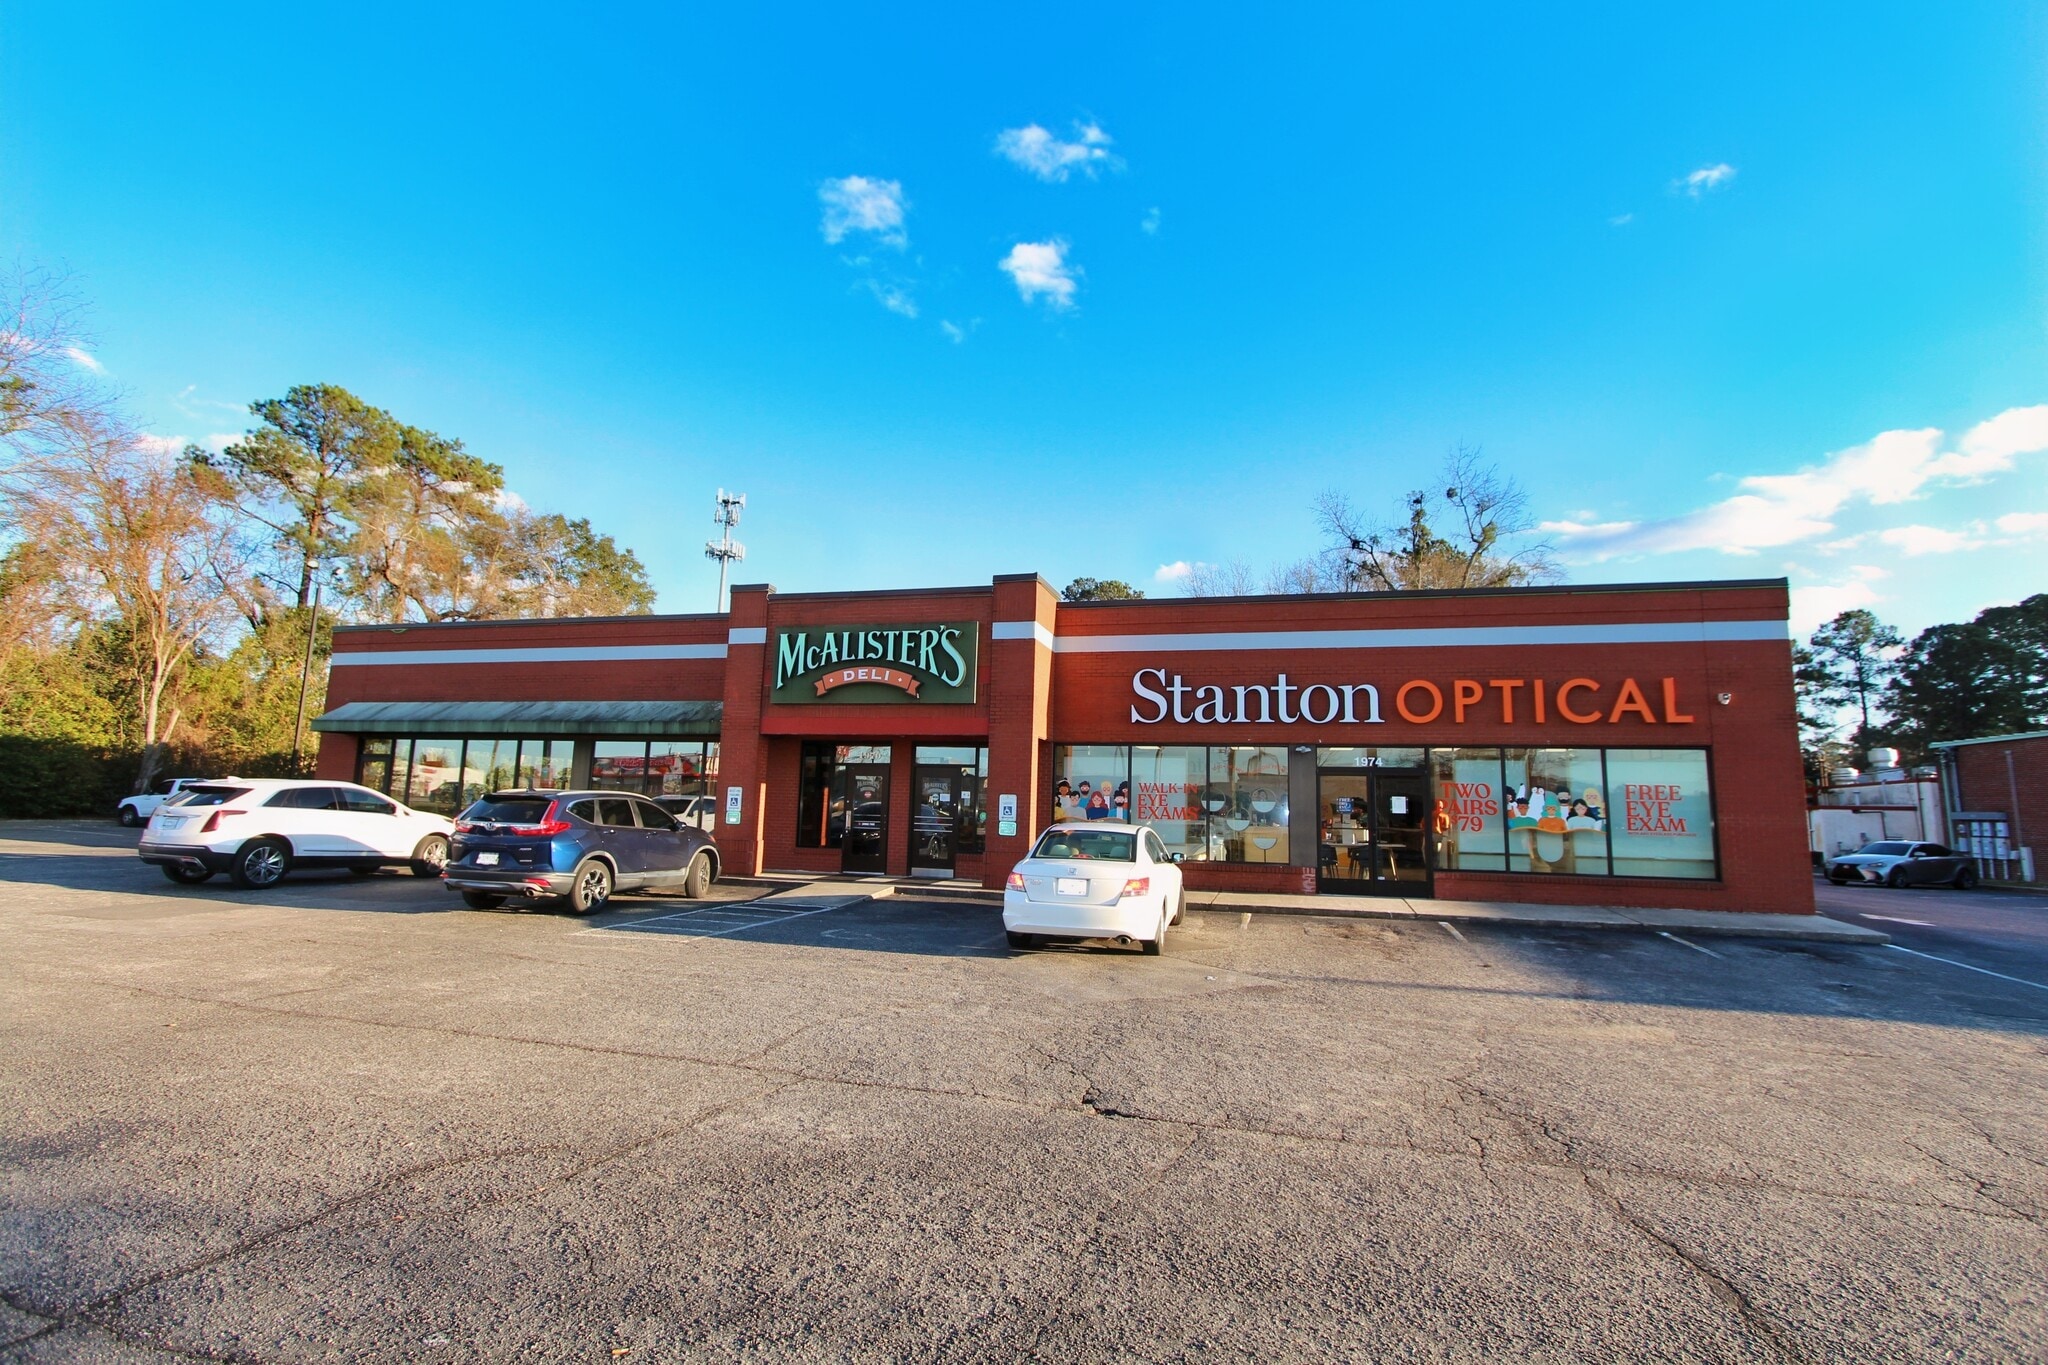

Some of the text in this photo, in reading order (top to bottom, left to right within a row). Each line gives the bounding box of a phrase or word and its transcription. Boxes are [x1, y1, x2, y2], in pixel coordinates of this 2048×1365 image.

[776, 625, 967, 690] McALISTER'S
[843, 668, 890, 682] DELI
[1130, 667, 1695, 725] Stanton OPTICAL
[1354, 756, 1383, 767] 1974
[1138, 782, 1199, 794] WALK-IN
[1440, 782, 1491, 799] TWO
[1625, 784, 1682, 801] FREE
[1138, 793, 1168, 807] EYE
[1436, 799, 1498, 816] PAIRS
[1626, 801, 1672, 818] EYE
[1451, 815, 1484, 832] $79
